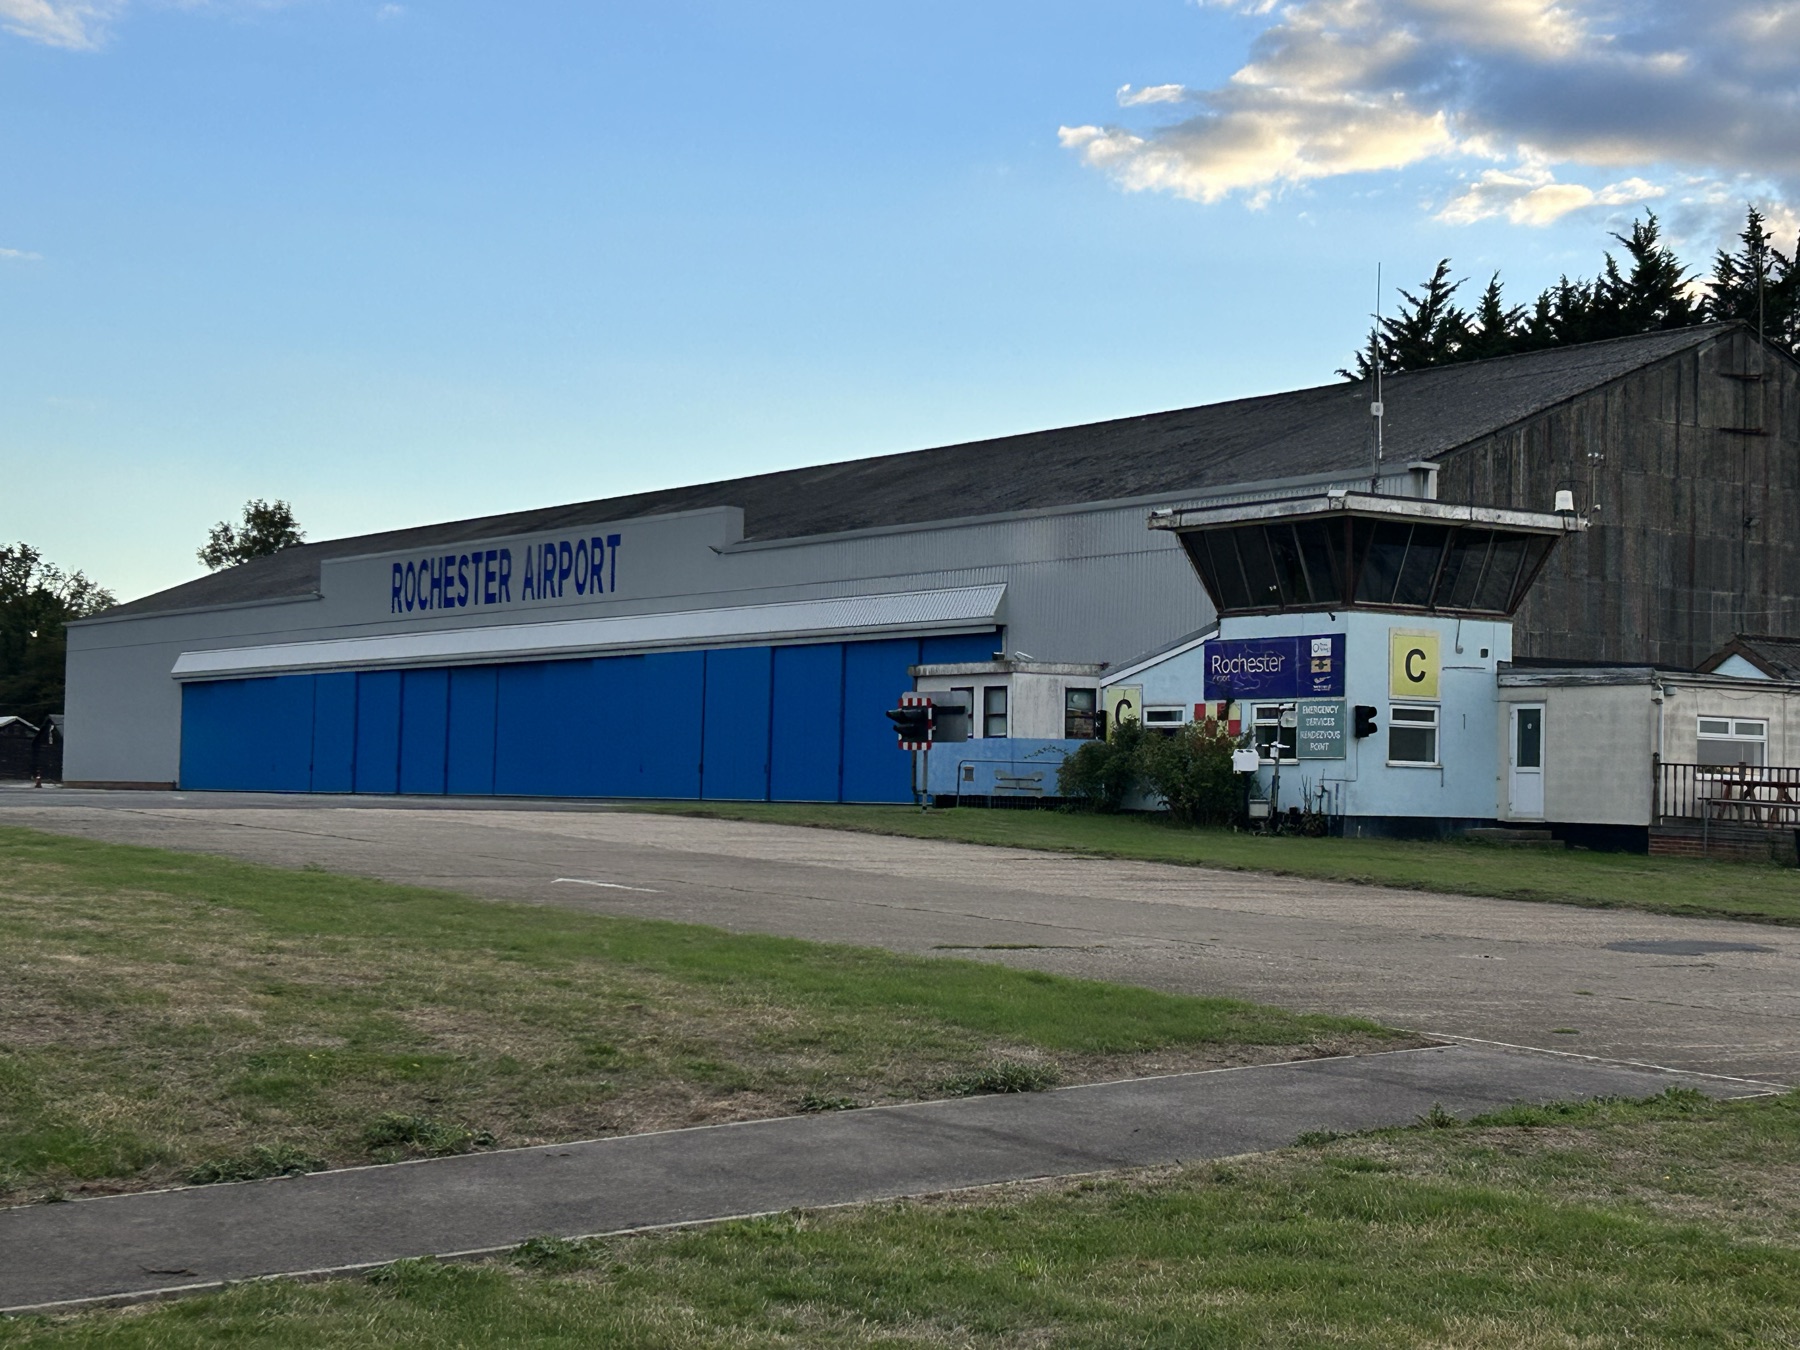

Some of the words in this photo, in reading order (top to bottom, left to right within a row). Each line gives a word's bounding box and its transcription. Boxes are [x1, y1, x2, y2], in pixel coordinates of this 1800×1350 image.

[391, 548, 512, 614] ROCHESTER
[522, 534, 622, 601] AIRPORT
[1212, 653, 1285, 674] Rochester
[1405, 648, 1426, 683] C
[1115, 699, 1132, 727] C
[1302, 705, 1339, 714] EMERGENCY
[1306, 718, 1335, 726] SERVICES
[1300, 731, 1341, 739] RENDEZVOUS
[1310, 743, 1329, 751] POINT
